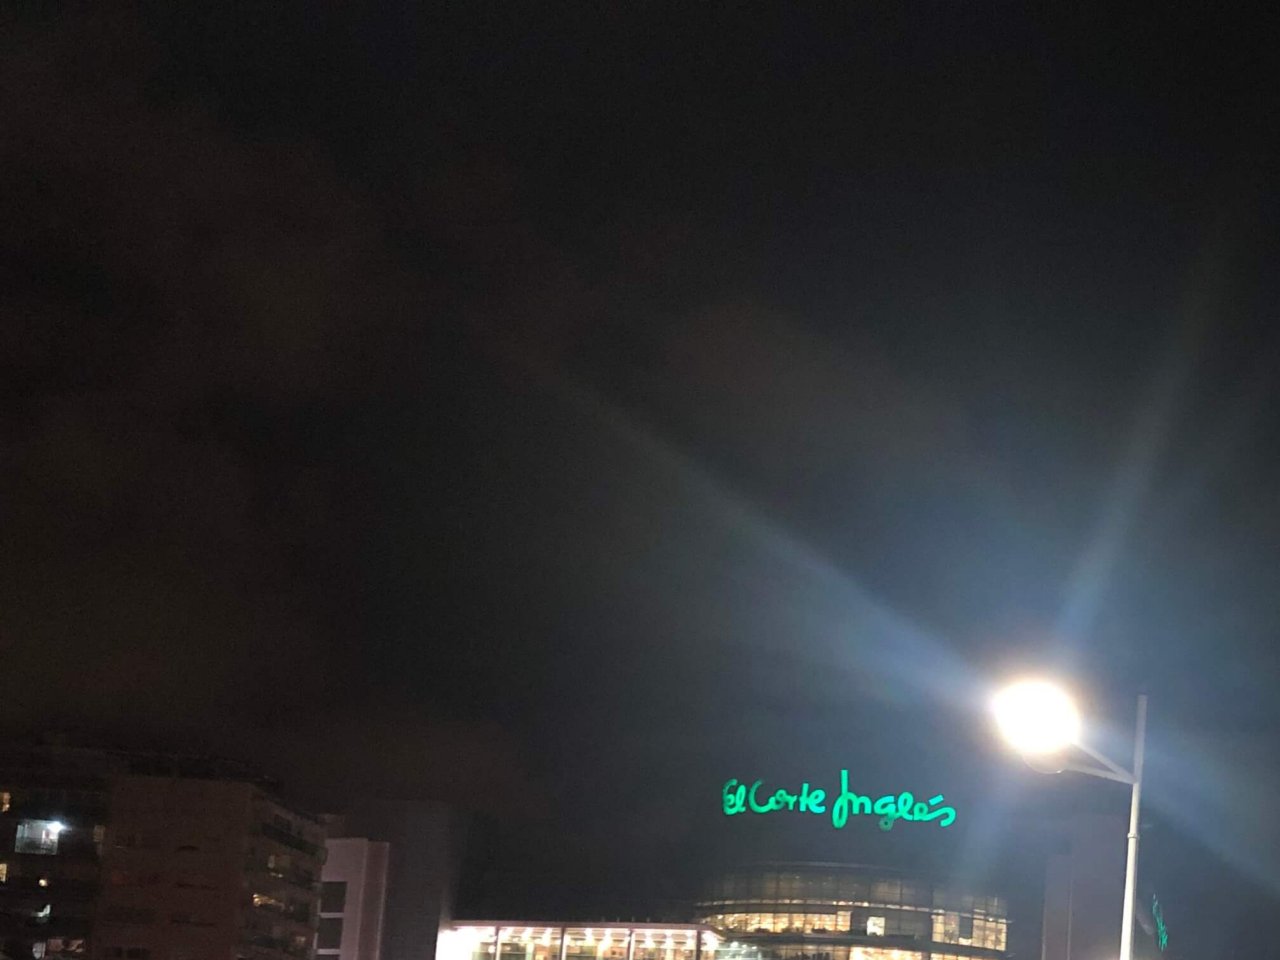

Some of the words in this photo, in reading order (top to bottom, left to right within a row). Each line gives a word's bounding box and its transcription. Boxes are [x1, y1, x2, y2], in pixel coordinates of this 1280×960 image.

[721, 778, 747, 815] El
[748, 779, 826, 814] Corte
[832, 769, 956, 830] Inglés
